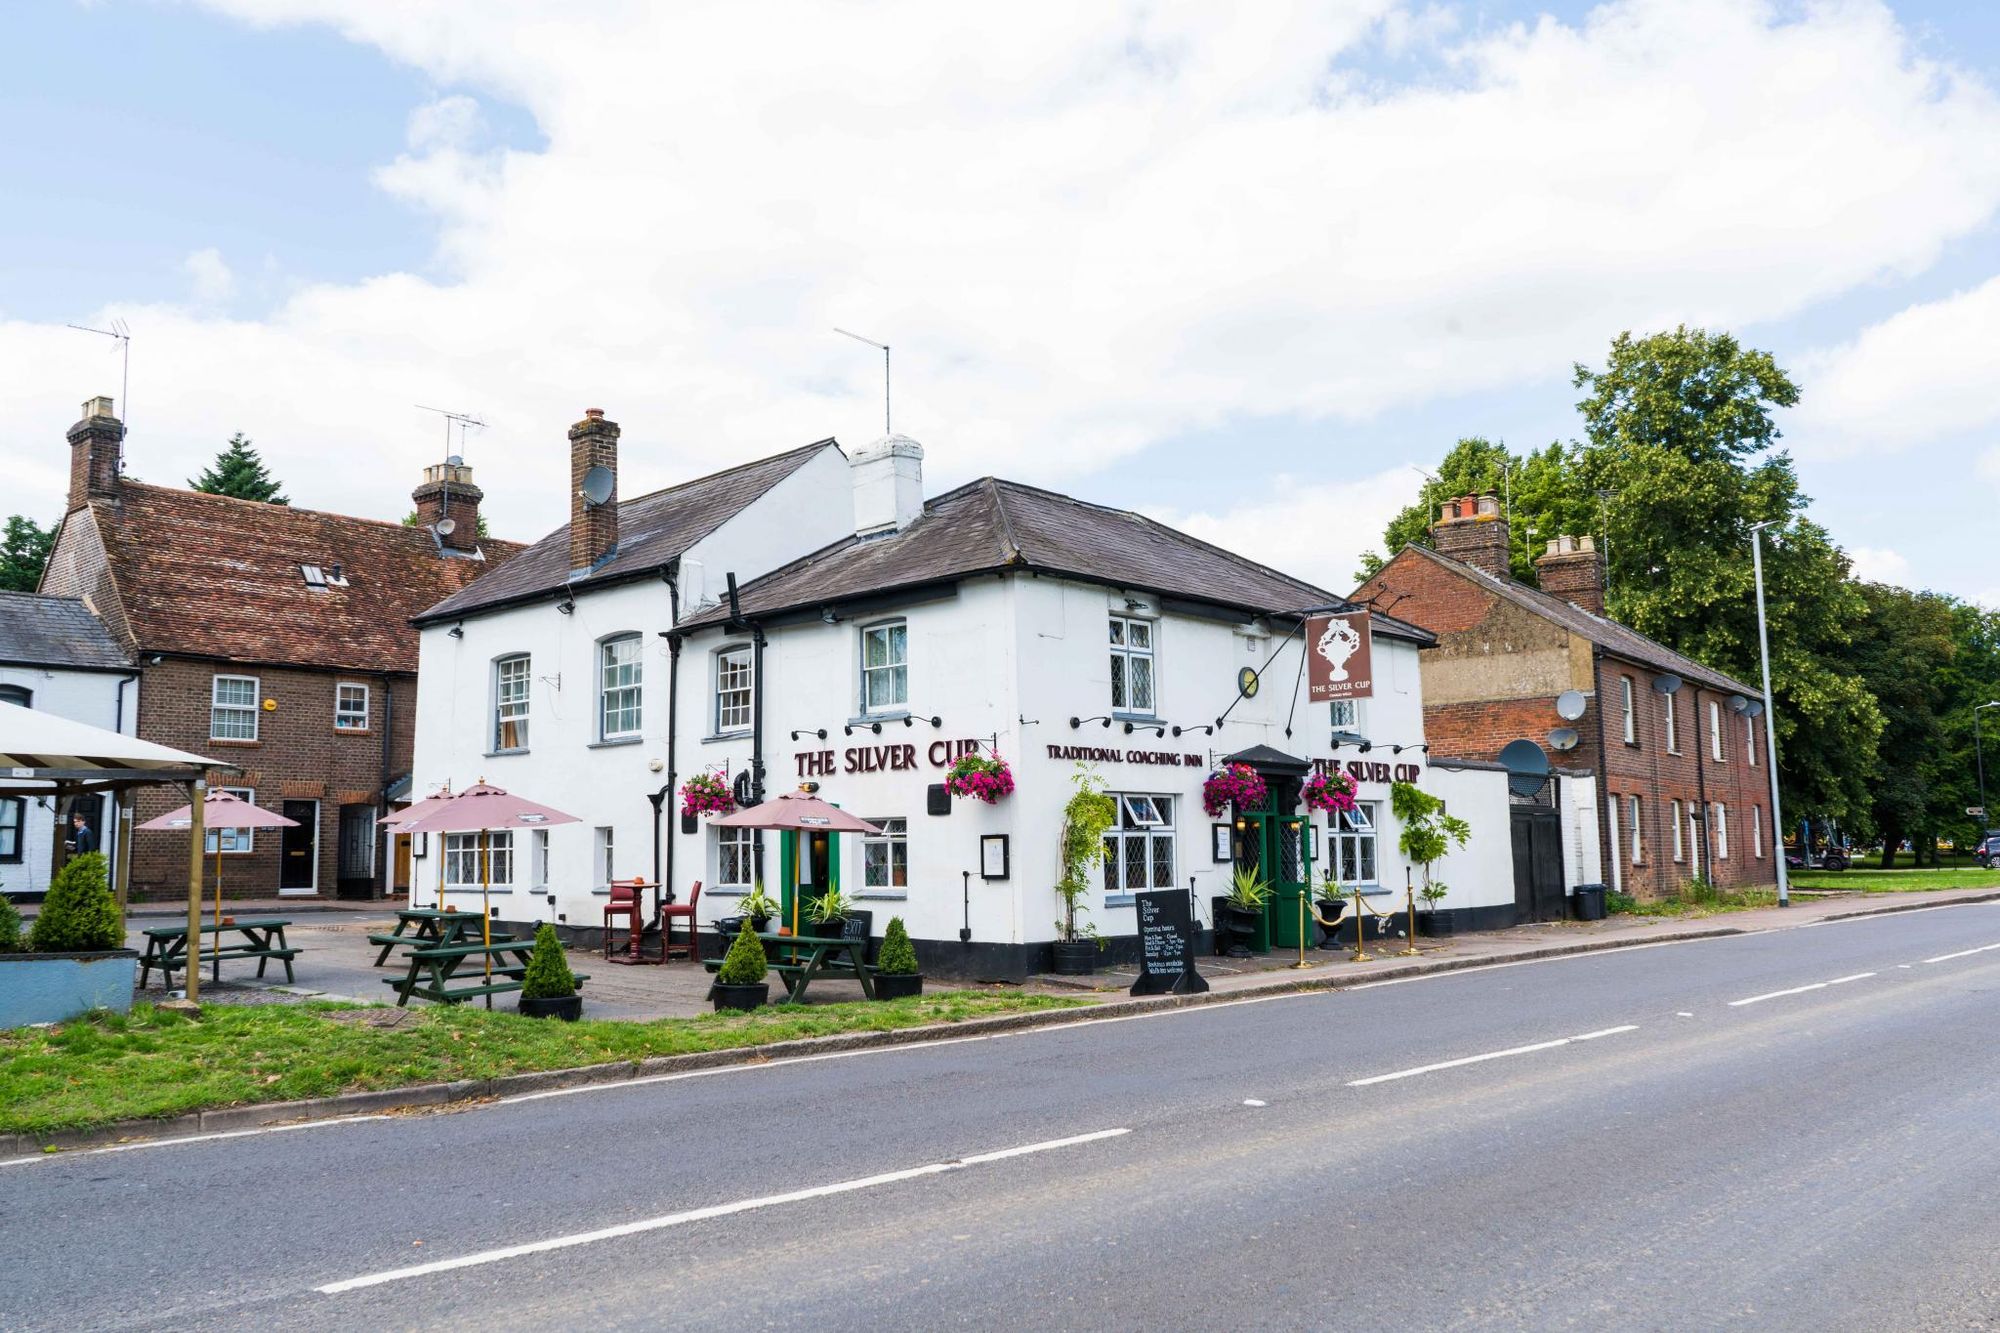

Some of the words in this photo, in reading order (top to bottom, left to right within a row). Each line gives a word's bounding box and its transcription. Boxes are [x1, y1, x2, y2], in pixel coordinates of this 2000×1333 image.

[1311, 685, 1326, 693] THE
[1328, 682, 1352, 691] SILVER
[1354, 680, 1371, 689] CUP
[794, 750, 837, 777] THE
[844, 743, 918, 773] SILVER
[1046, 745, 1124, 762] TRADITIONAL
[1126, 750, 1181, 766] COACHING
[1183, 753, 1203, 767] INN
[1347, 761, 1392, 783] SILVER
[1394, 763, 1420, 783] CUP
